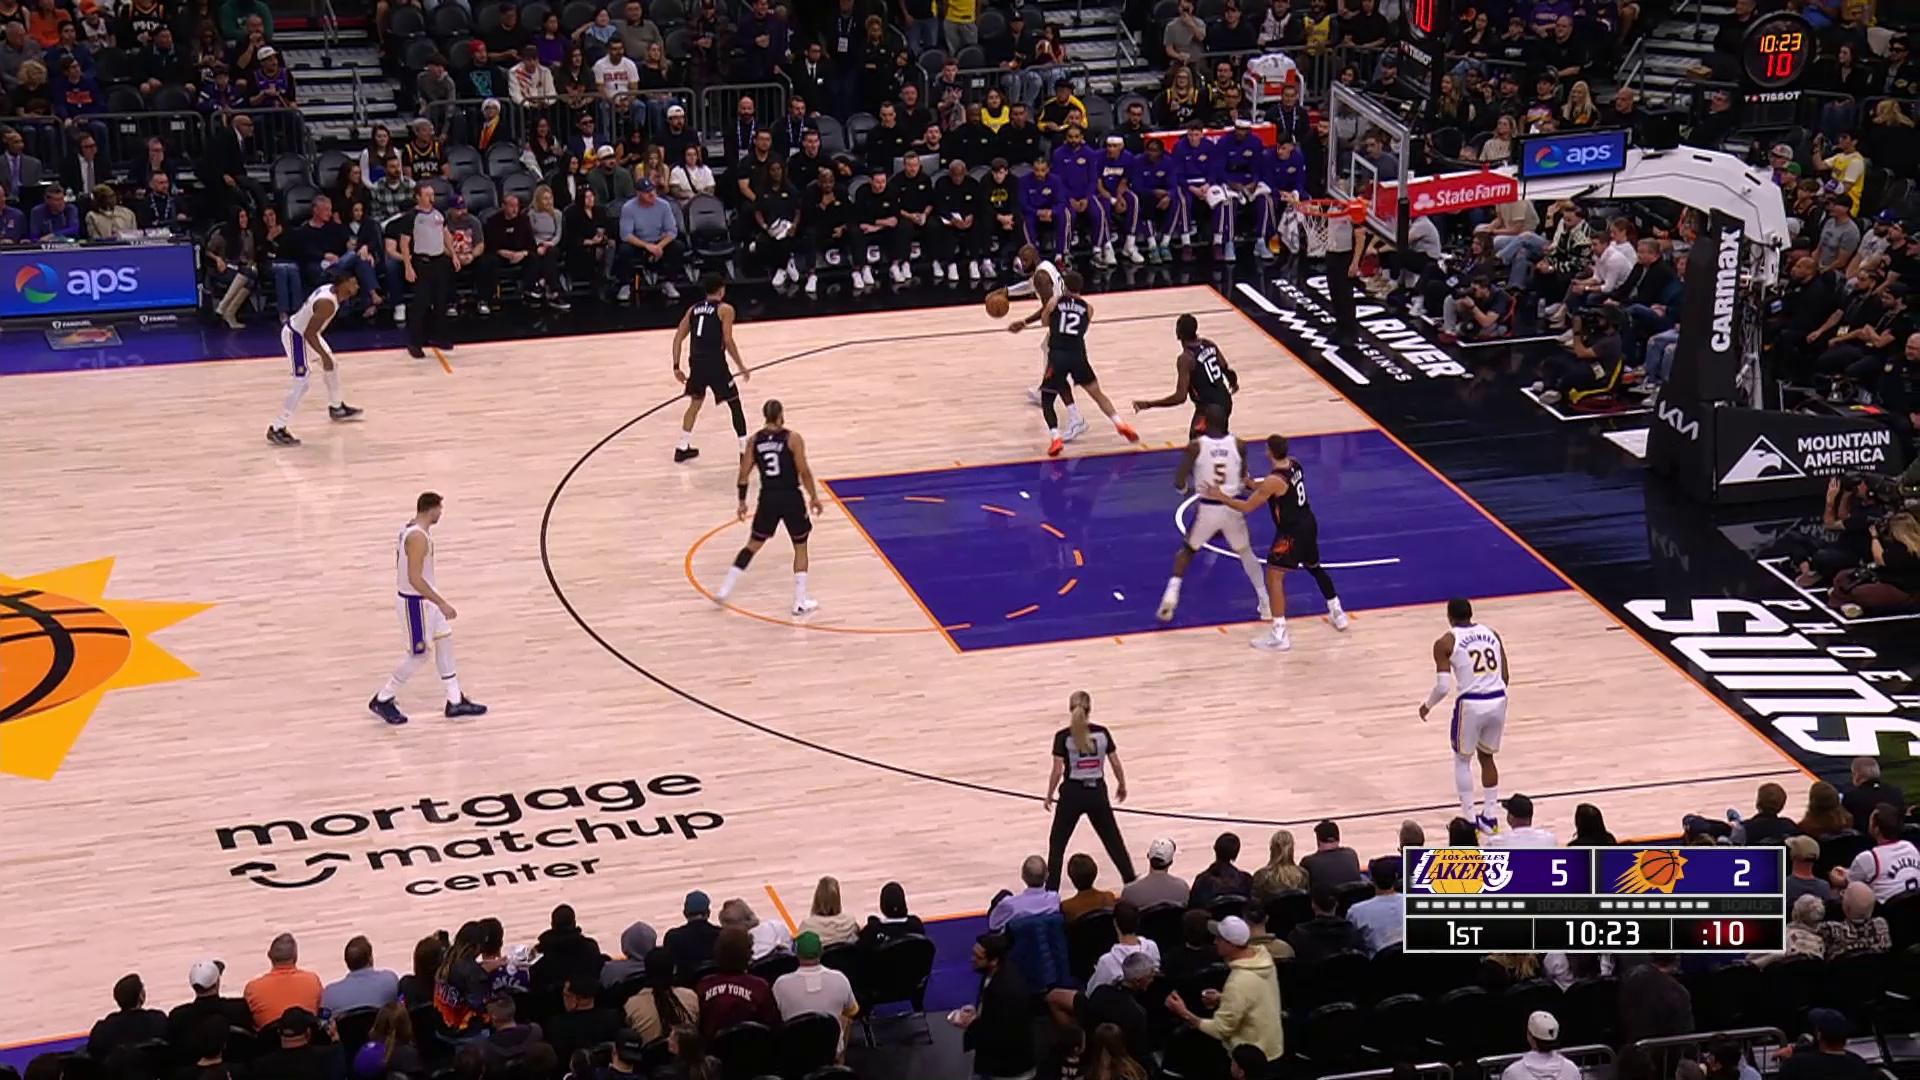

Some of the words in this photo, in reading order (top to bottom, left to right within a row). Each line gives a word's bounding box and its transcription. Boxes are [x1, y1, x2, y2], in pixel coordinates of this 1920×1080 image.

[1760, 32, 1802, 53] 10:23
[1766, 52, 1793, 77] 10
[1760, 91, 1801, 102] TISSOT
[1566, 145, 1612, 165] aps
[66, 267, 139, 300] aps
[697, 315, 704, 336] 1
[1059, 312, 1080, 334] 12
[1355, 337, 1412, 380] ASINOS
[1359, 318, 1466, 378] RIVER
[1204, 357, 1221, 383] 15
[1797, 430, 1890, 452] MOUNTAIN
[764, 452, 780, 476] 3
[1804, 447, 1884, 468] AMERICA
[1214, 464, 1226, 484] 5
[1296, 482, 1306, 506] 8
[1469, 648, 1497, 672] 28
[1623, 599, 1920, 757] SUNS
[216, 773, 702, 850] mortgage
[366, 810, 725, 870] matchup
[405, 858, 600, 896] center
[705, 984, 727, 1000] NEW
[728, 984, 752, 1001] YORK
